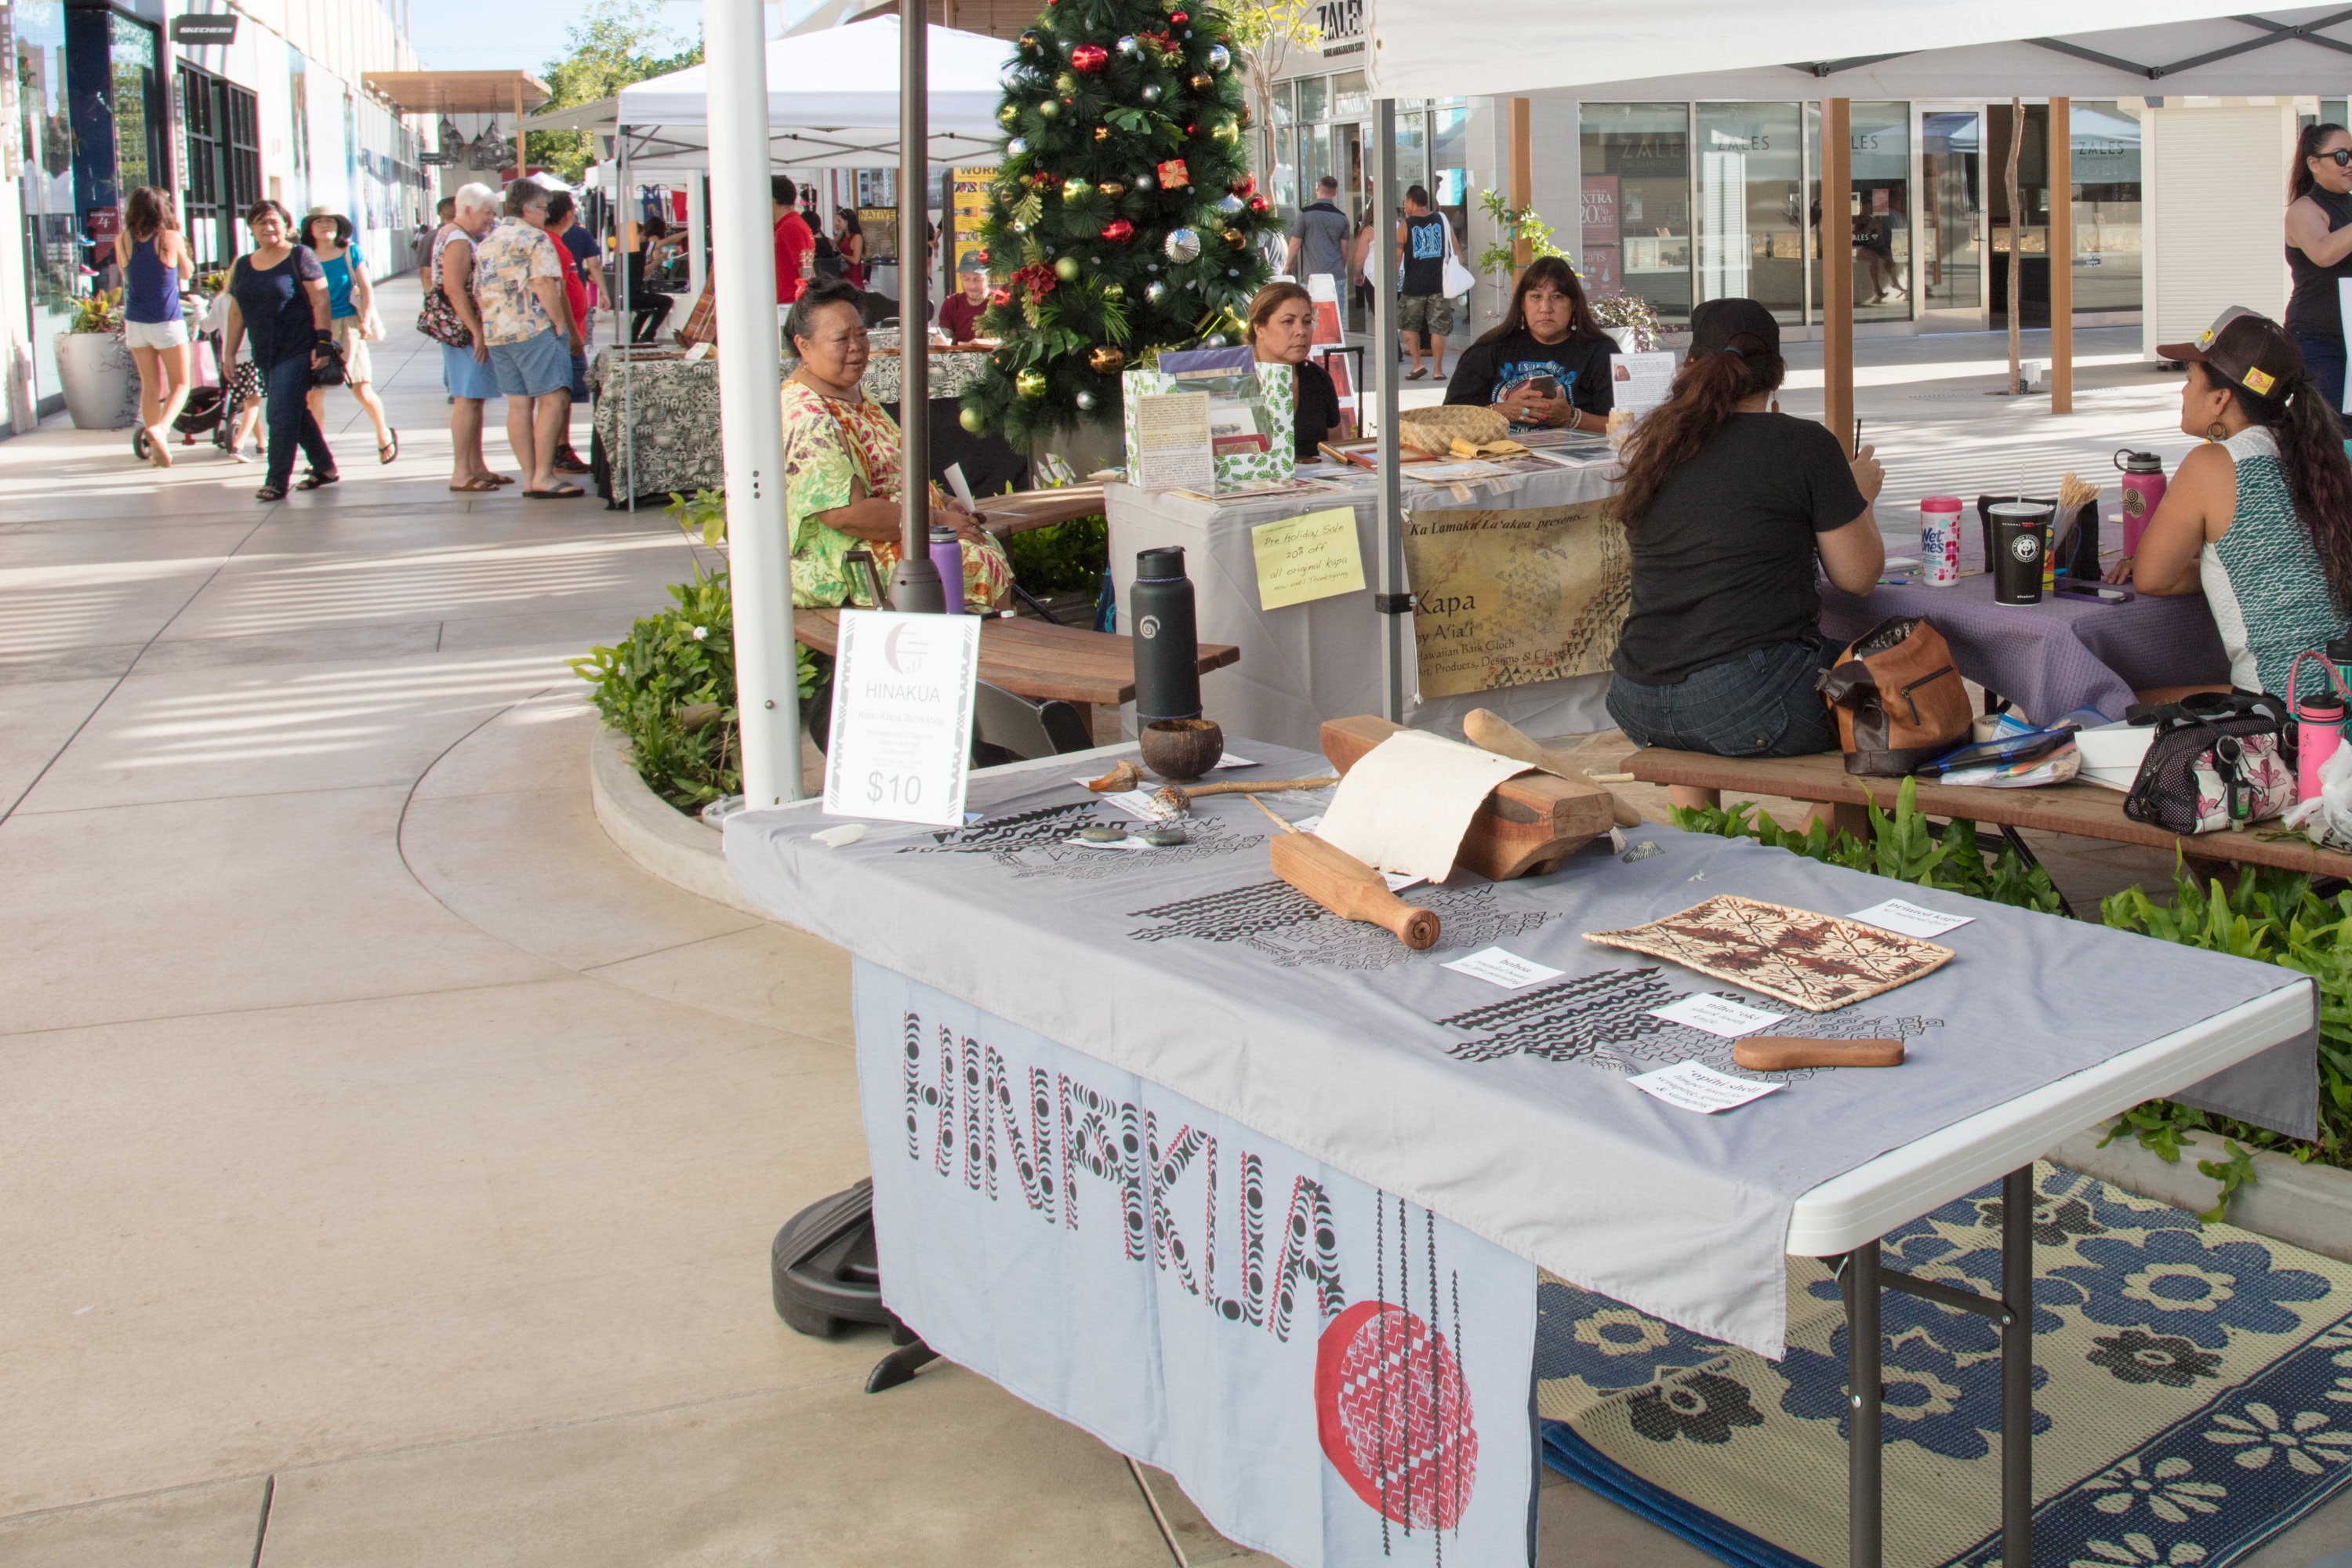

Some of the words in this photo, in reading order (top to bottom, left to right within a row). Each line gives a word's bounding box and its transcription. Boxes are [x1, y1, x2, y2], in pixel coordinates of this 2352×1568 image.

[1621, 138, 1681, 158] ZALE
[1851, 135, 1879, 151] LES
[2078, 141, 2125, 155] ZALES
[1582, 194, 1613, 204] XTRA
[859, 210, 895, 219] NATIVE
[1599, 215, 1613, 223] OFF
[1264, 537, 1279, 546] Pre
[1323, 523, 1344, 533] Sale
[1410, 524, 1427, 535] Ka
[1431, 521, 1478, 534] Lamaku
[1922, 527, 1945, 543] Wet
[1308, 542, 1328, 554] off
[1270, 568, 1283, 579] all
[1287, 560, 1322, 577] original
[1414, 590, 1476, 618] Kapa
[1417, 648, 1459, 662] Hawaiian
[1461, 643, 1483, 654] Bark
[1486, 638, 1515, 652] Cloth
[1436, 661, 1479, 674] Products,
[1481, 655, 1519, 668] Designs
[1523, 652, 1532, 661] &
[866, 682, 941, 702] HINAKUA
[858, 710, 877, 721] Keiki
[880, 712, 902, 722] Kapa
[904, 713, 946, 726] Workshop
[866, 770, 921, 805] $10
[1887, 902, 1933, 916] printed
[1706, 1002, 1733, 1014] niho
[1727, 1084, 1762, 1093] shell
[904, 1010, 1346, 1344] HINAKUA
